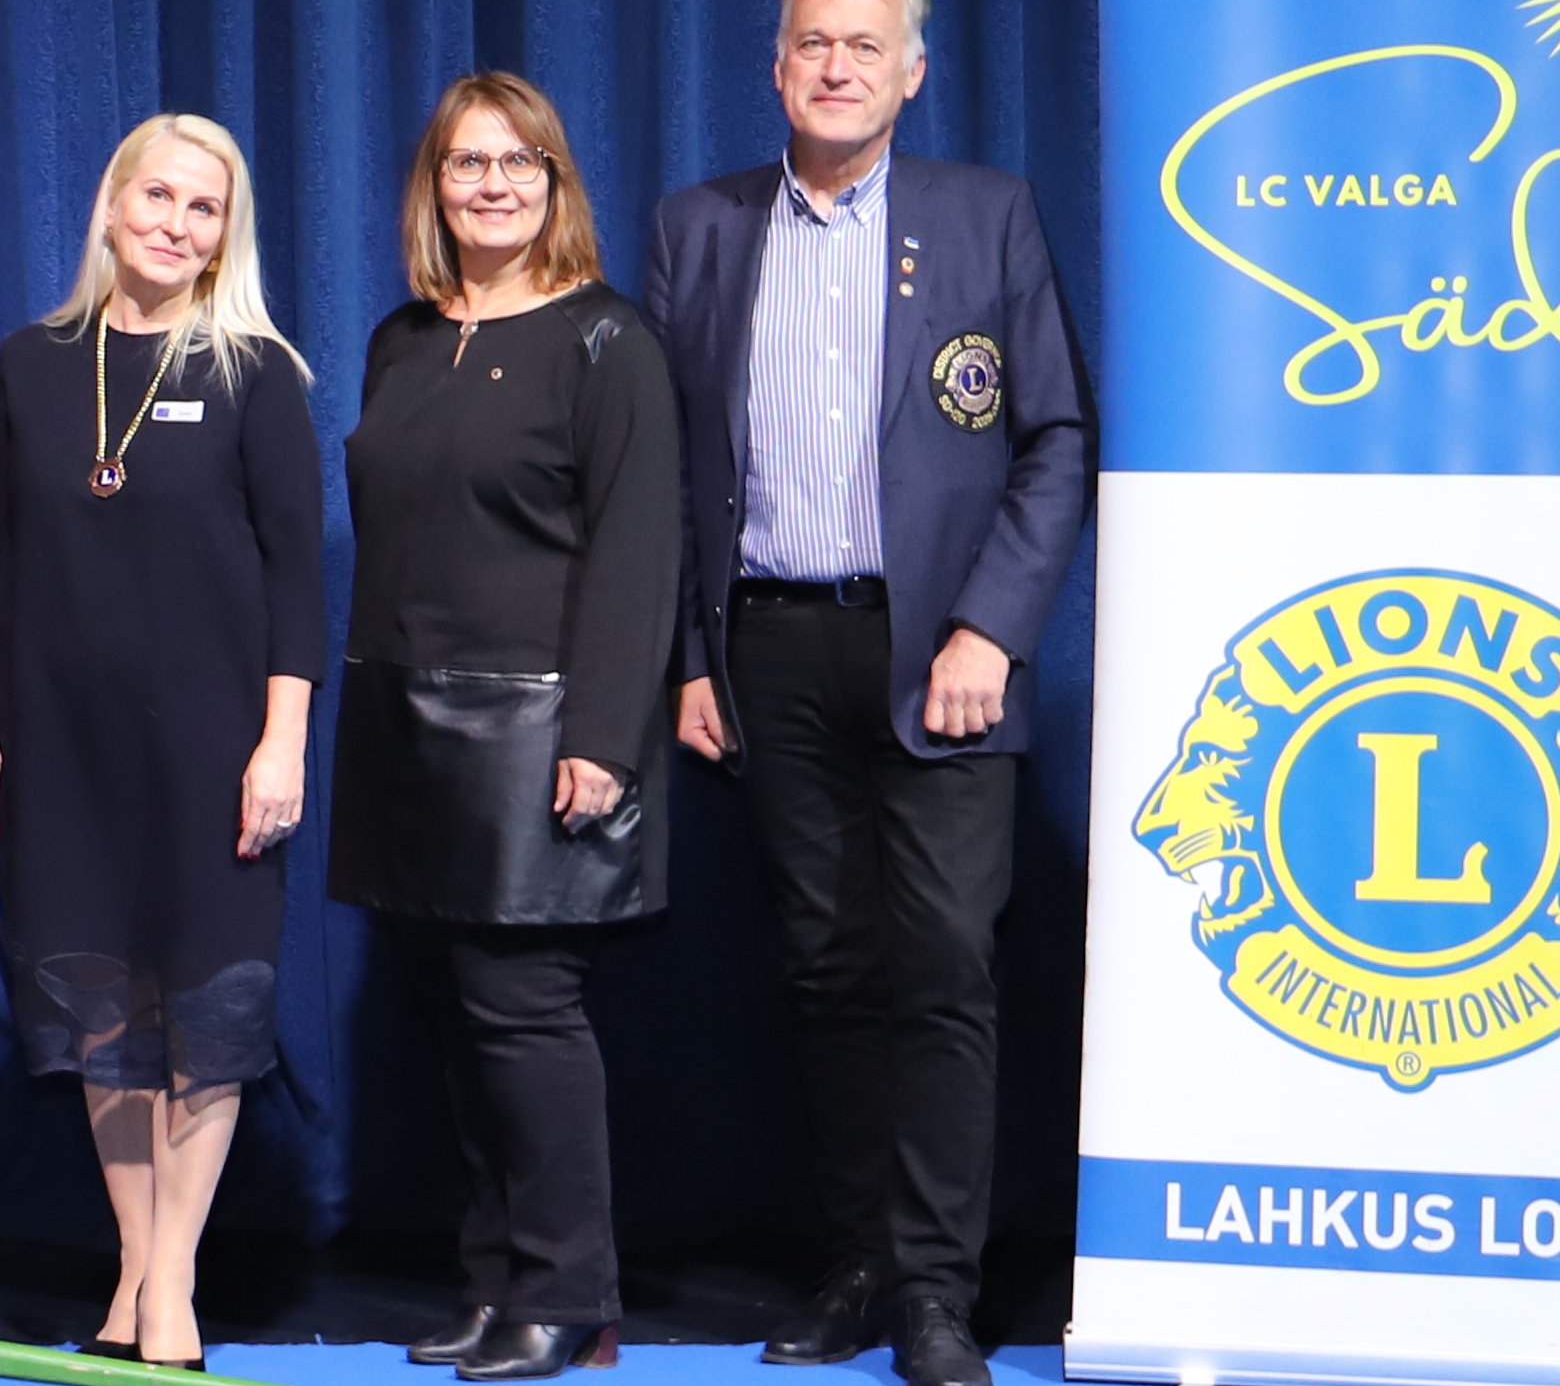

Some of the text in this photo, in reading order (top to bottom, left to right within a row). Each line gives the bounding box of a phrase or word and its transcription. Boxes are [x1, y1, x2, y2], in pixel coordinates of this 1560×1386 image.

[1236, 173, 1458, 208] LC VALGA
[967, 367, 983, 392] L
[1354, 732, 1492, 904] L
[1164, 1180, 1458, 1255] LAHKUS
